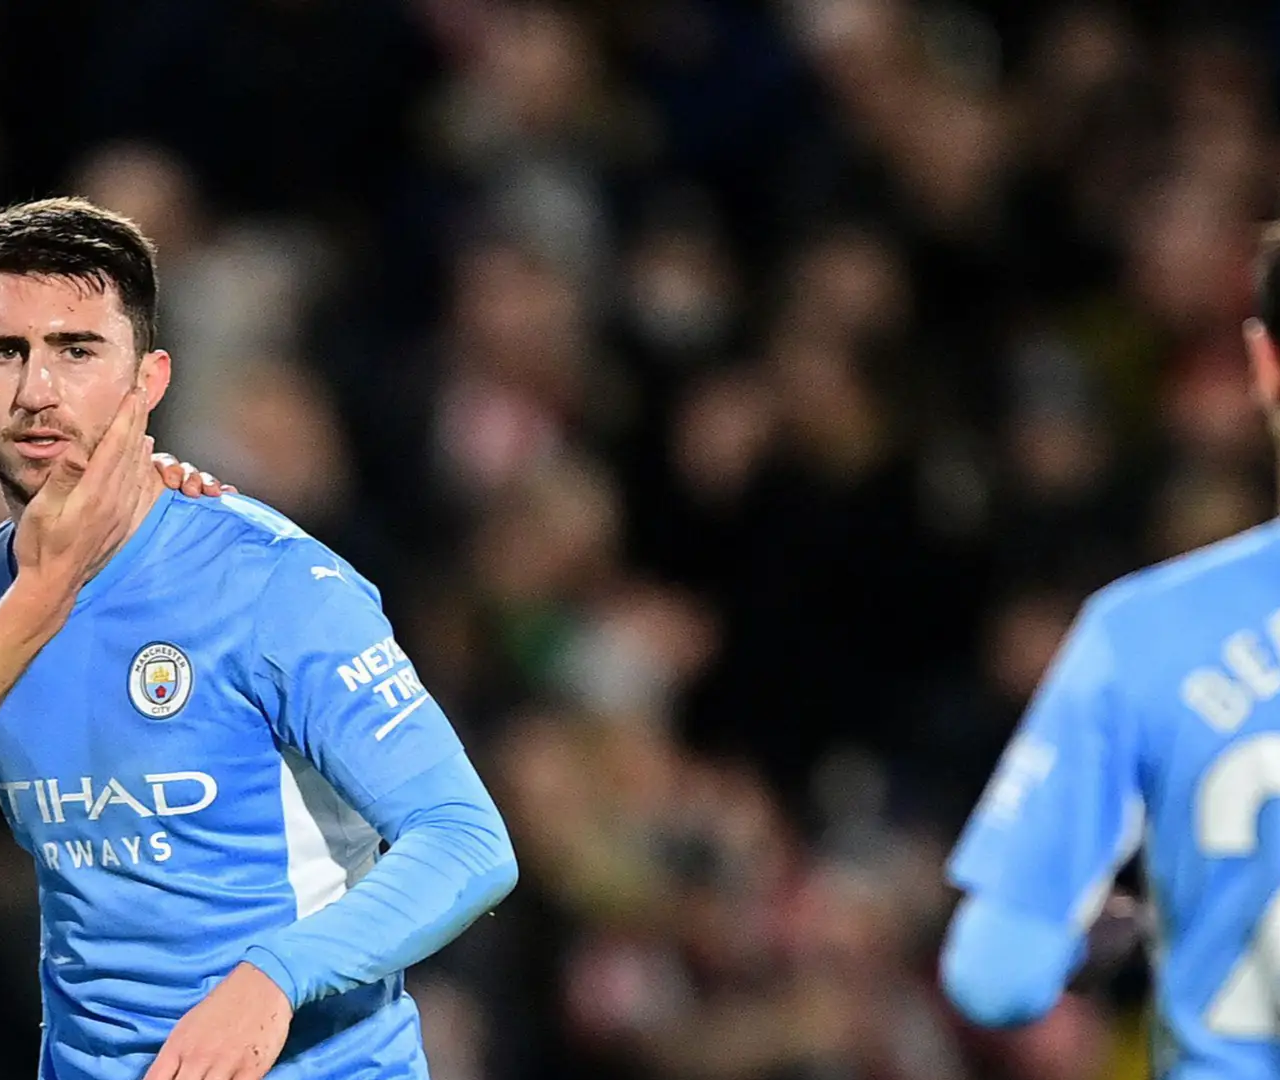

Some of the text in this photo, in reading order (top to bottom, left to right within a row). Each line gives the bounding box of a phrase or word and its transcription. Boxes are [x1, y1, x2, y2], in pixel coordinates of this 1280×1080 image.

[135, 647, 185, 672] MANCHESTER
[371, 665, 424, 709] TIR
[152, 706, 171, 714] CITY
[41, 831, 173, 871] RWAYS
